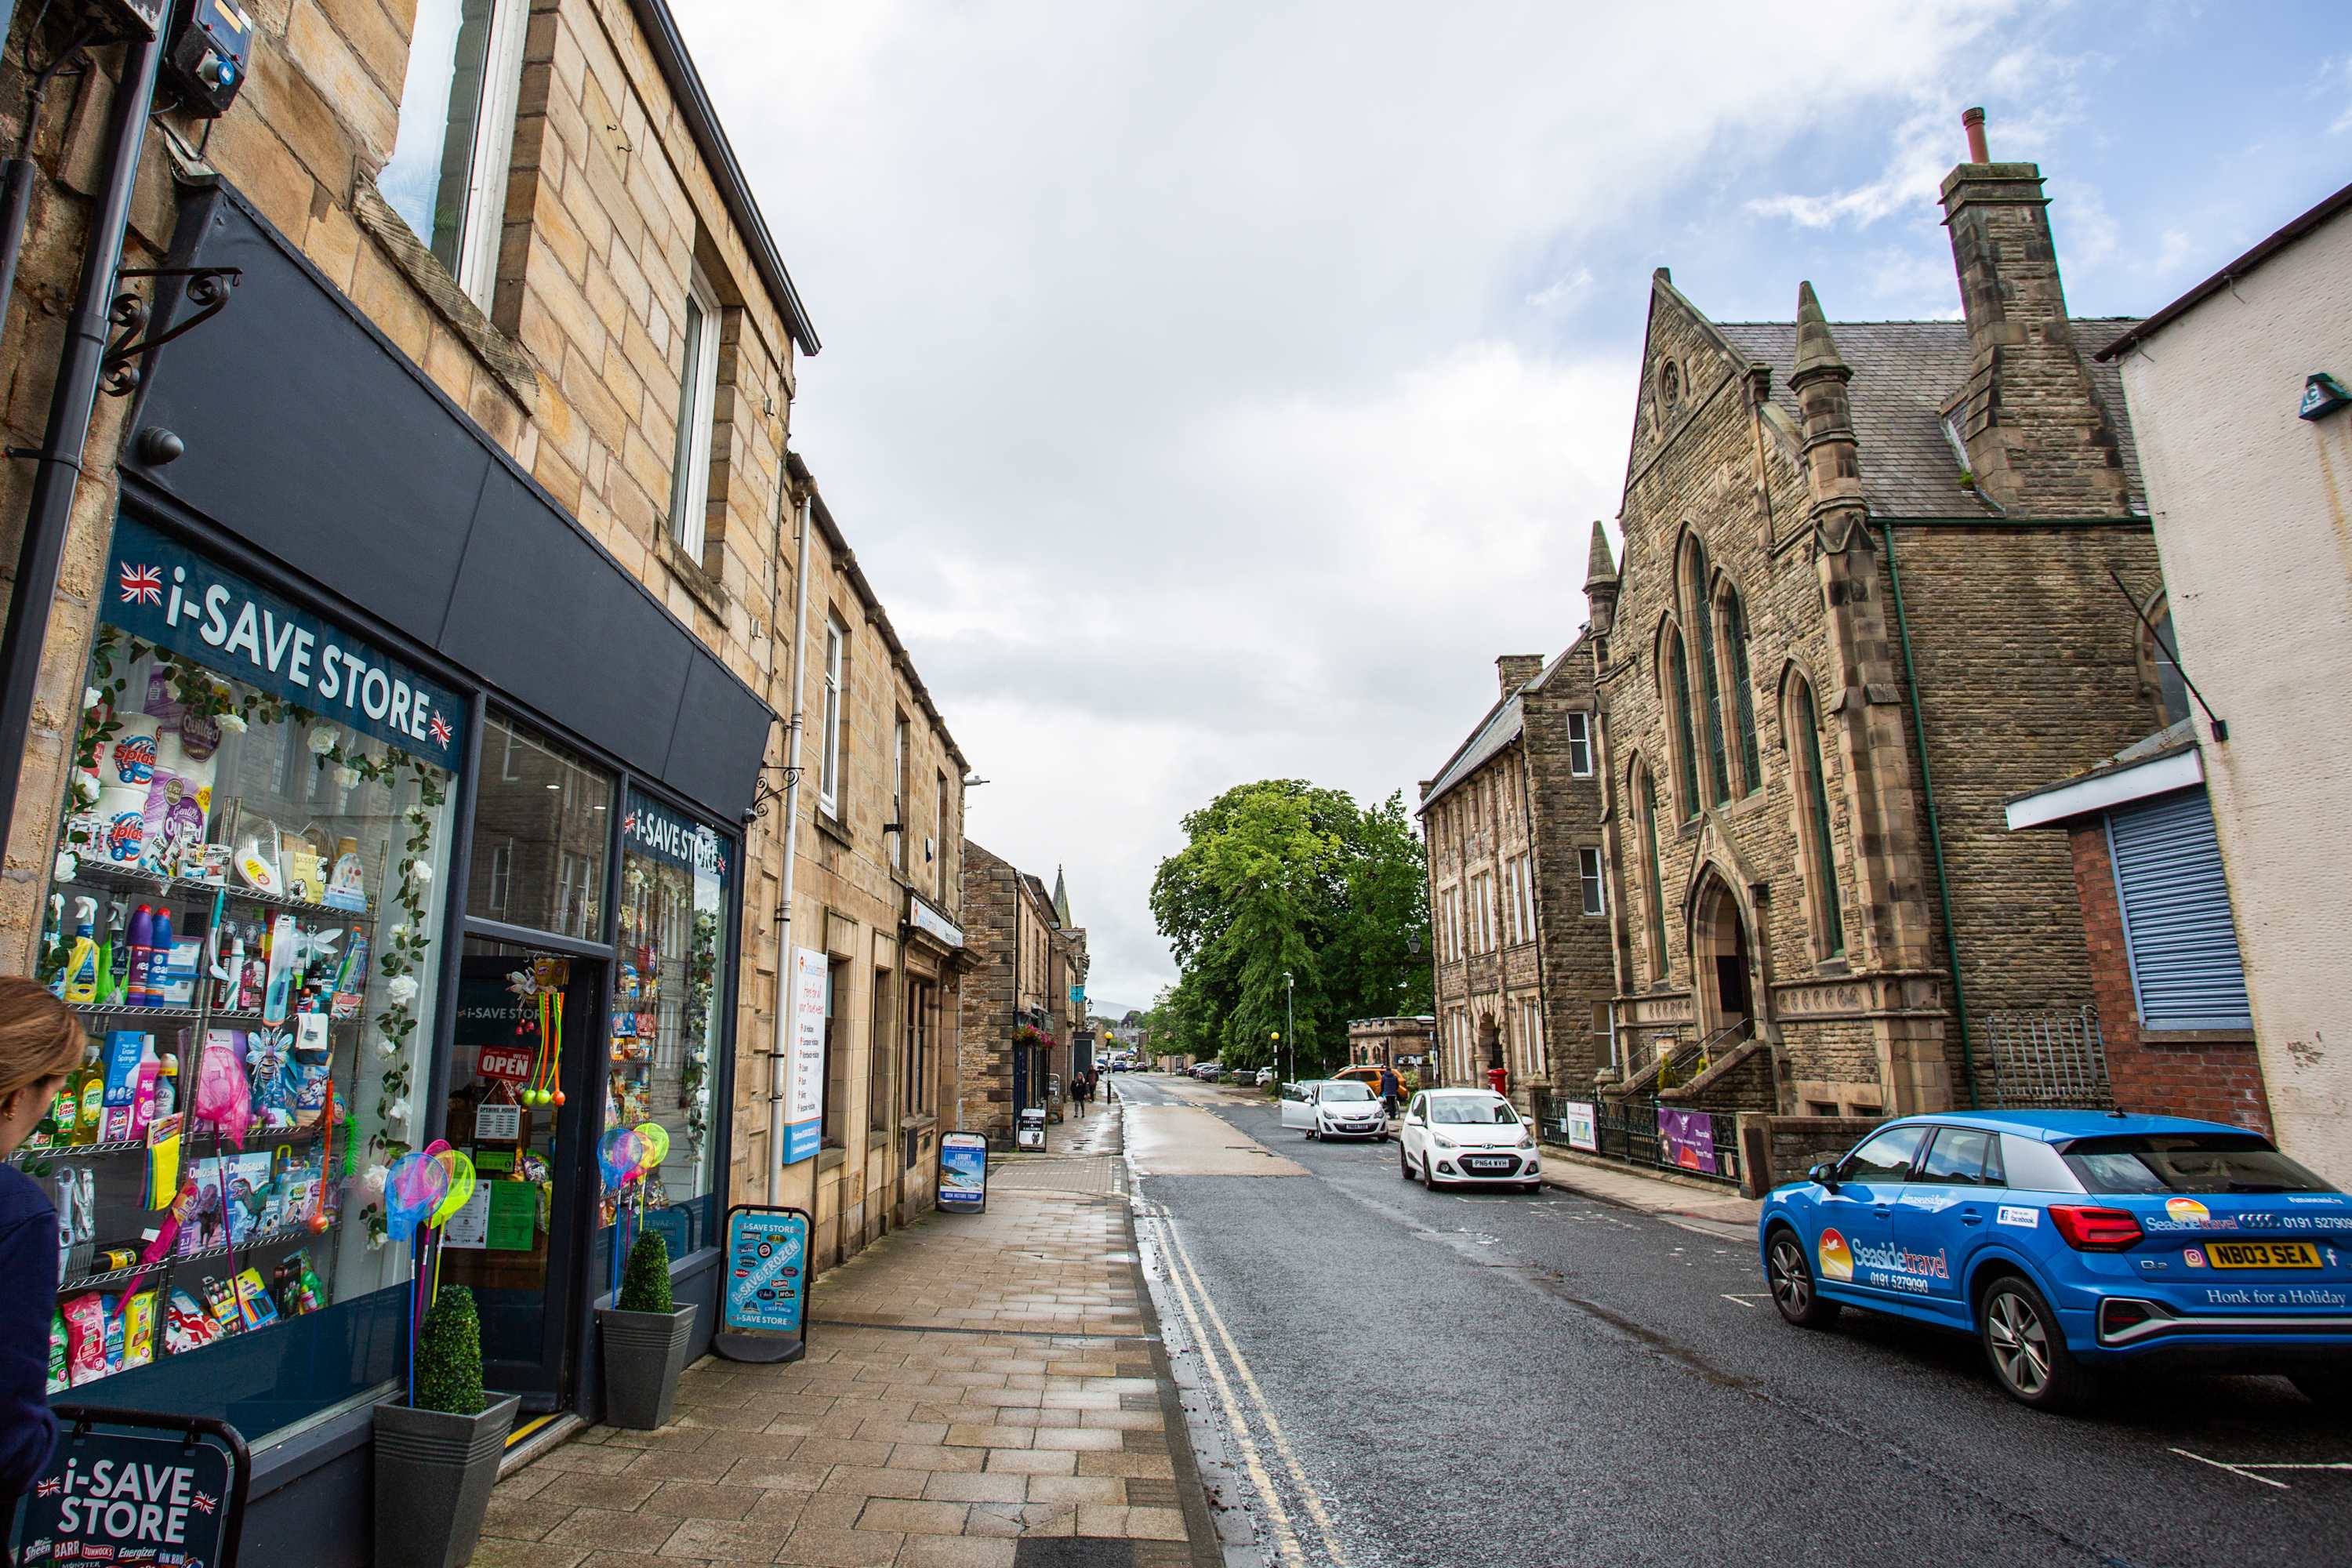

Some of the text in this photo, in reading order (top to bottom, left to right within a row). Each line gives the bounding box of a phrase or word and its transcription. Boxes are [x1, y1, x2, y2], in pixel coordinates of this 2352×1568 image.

[165, 565, 430, 742] i-SAVE STORE
[113, 744, 156, 766] Splas
[636, 808, 718, 873] i-SAVE STORE
[466, 1007, 541, 1020] i-SAVE STOR
[482, 1054, 528, 1076] OPEN
[188, 1166, 220, 1179] DINOSA
[228, 1162, 266, 1174] DINOSAUR
[743, 1223, 795, 1233] i-SAVE STORE
[2010, 1214, 2034, 1224] facebook
[2284, 1216, 2312, 1229] 0191
[2215, 1245, 2314, 1265] NB03 SEA
[732, 1240, 799, 1303] i-SAVE FROZEN
[1870, 1272, 1929, 1294] 0191 5279090
[2206, 1289, 2347, 1308] Honk for a Holiday
[736, 1315, 788, 1326] i-SAVE STORE
[63, 1457, 194, 1505] i-SAVE
[57, 1496, 189, 1544] STORE
[25, 1543, 51, 1561] Sheen
[54, 1540, 80, 1558] BARR
[118, 1546, 157, 1559] Energizer
